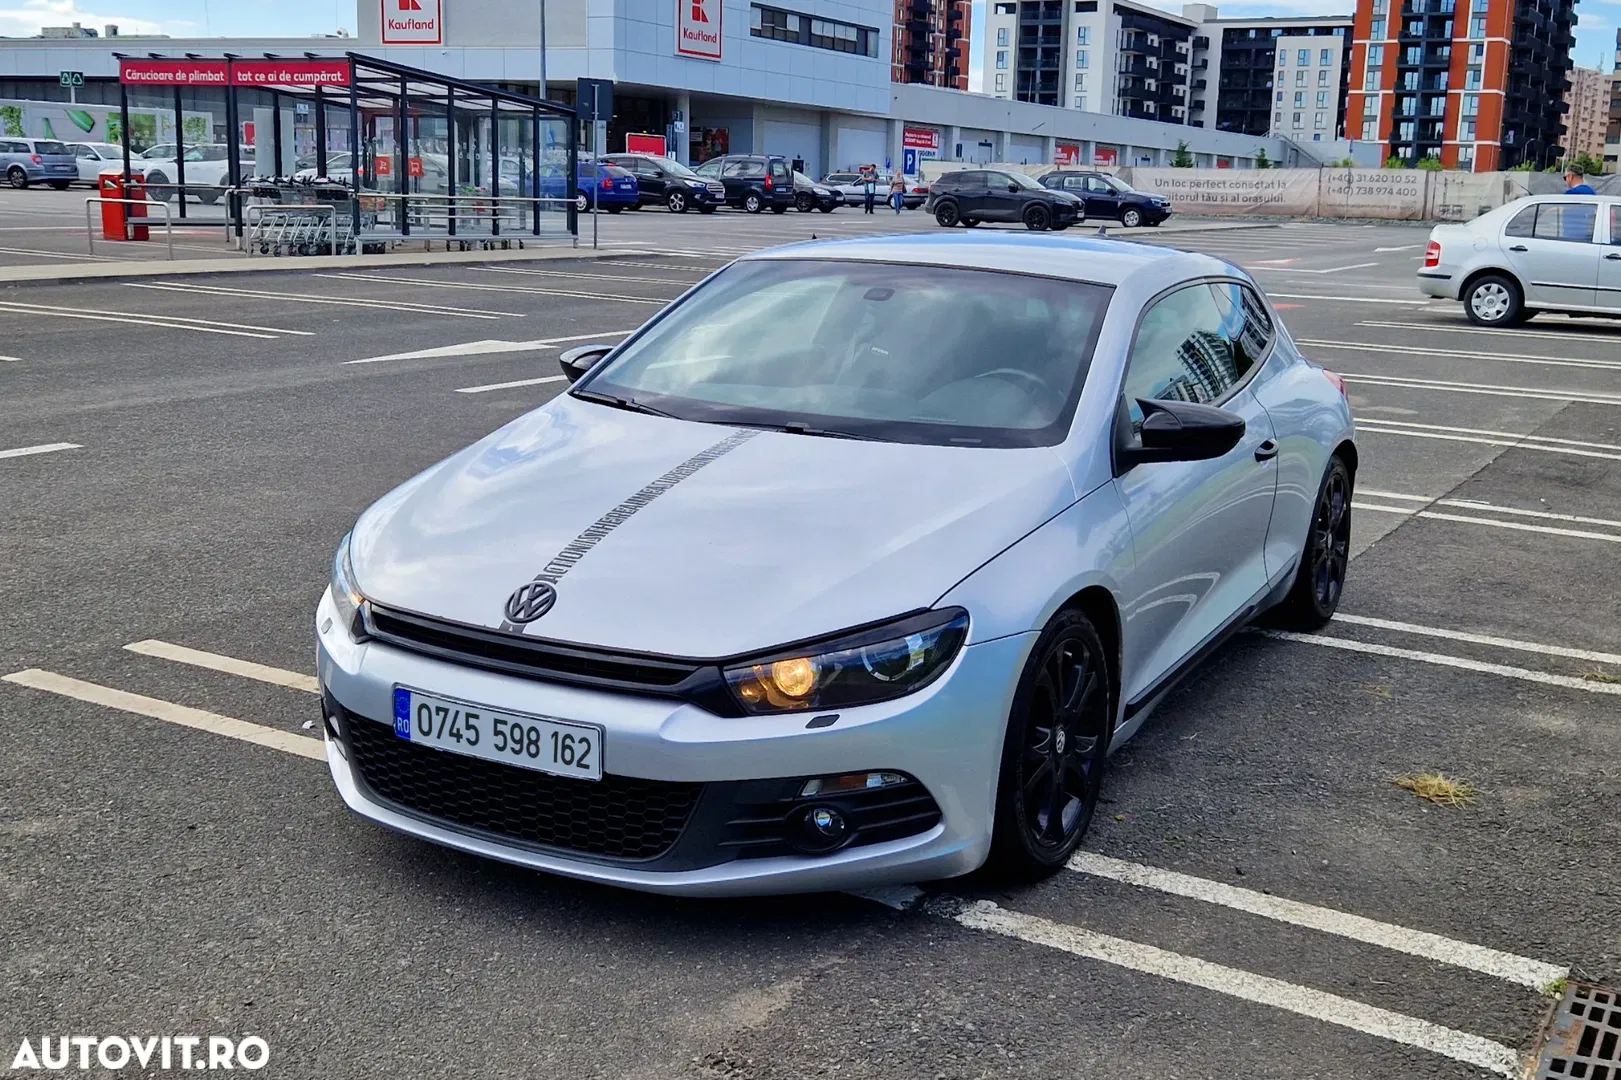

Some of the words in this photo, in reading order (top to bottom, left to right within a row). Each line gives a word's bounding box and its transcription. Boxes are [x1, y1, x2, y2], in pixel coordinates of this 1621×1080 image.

[388, 18, 434, 30] Kaufland
[683, 27, 717, 44] Kaufland
[125, 68, 174, 81] Cărucioare
[175, 69, 187, 81] de
[188, 69, 224, 83] plimbat
[237, 70, 253, 82] tot
[254, 72, 266, 82] ce
[267, 70, 277, 82] ai
[279, 69, 291, 82] de
[293, 70, 345, 84] cumpărat.
[906, 154, 914, 170] P
[1154, 178, 1169, 188] Un
[1171, 178, 1187, 188] loc
[1189, 178, 1227, 190] perfect
[1228, 180, 1275, 189] conectat
[1277, 180, 1287, 189] la
[1327, 173, 1354, 183] (+40)
[1356, 174, 1367, 183] 31
[1368, 174, 1389, 184] 620
[1391, 174, 1402, 184] 10
[1405, 175, 1417, 184] 52
[1327, 185, 1354, 196] (+40)
[1355, 186, 1374, 195] 738
[1375, 186, 1394, 196] 974
[1396, 187, 1417, 197] 400
[1201, 192, 1218, 202] tău
[1230, 193, 1240, 203] al
[397, 717, 410, 733] RO
[417, 703, 480, 746] 0745
[493, 717, 541, 759] 598
[551, 731, 591, 770] 162
